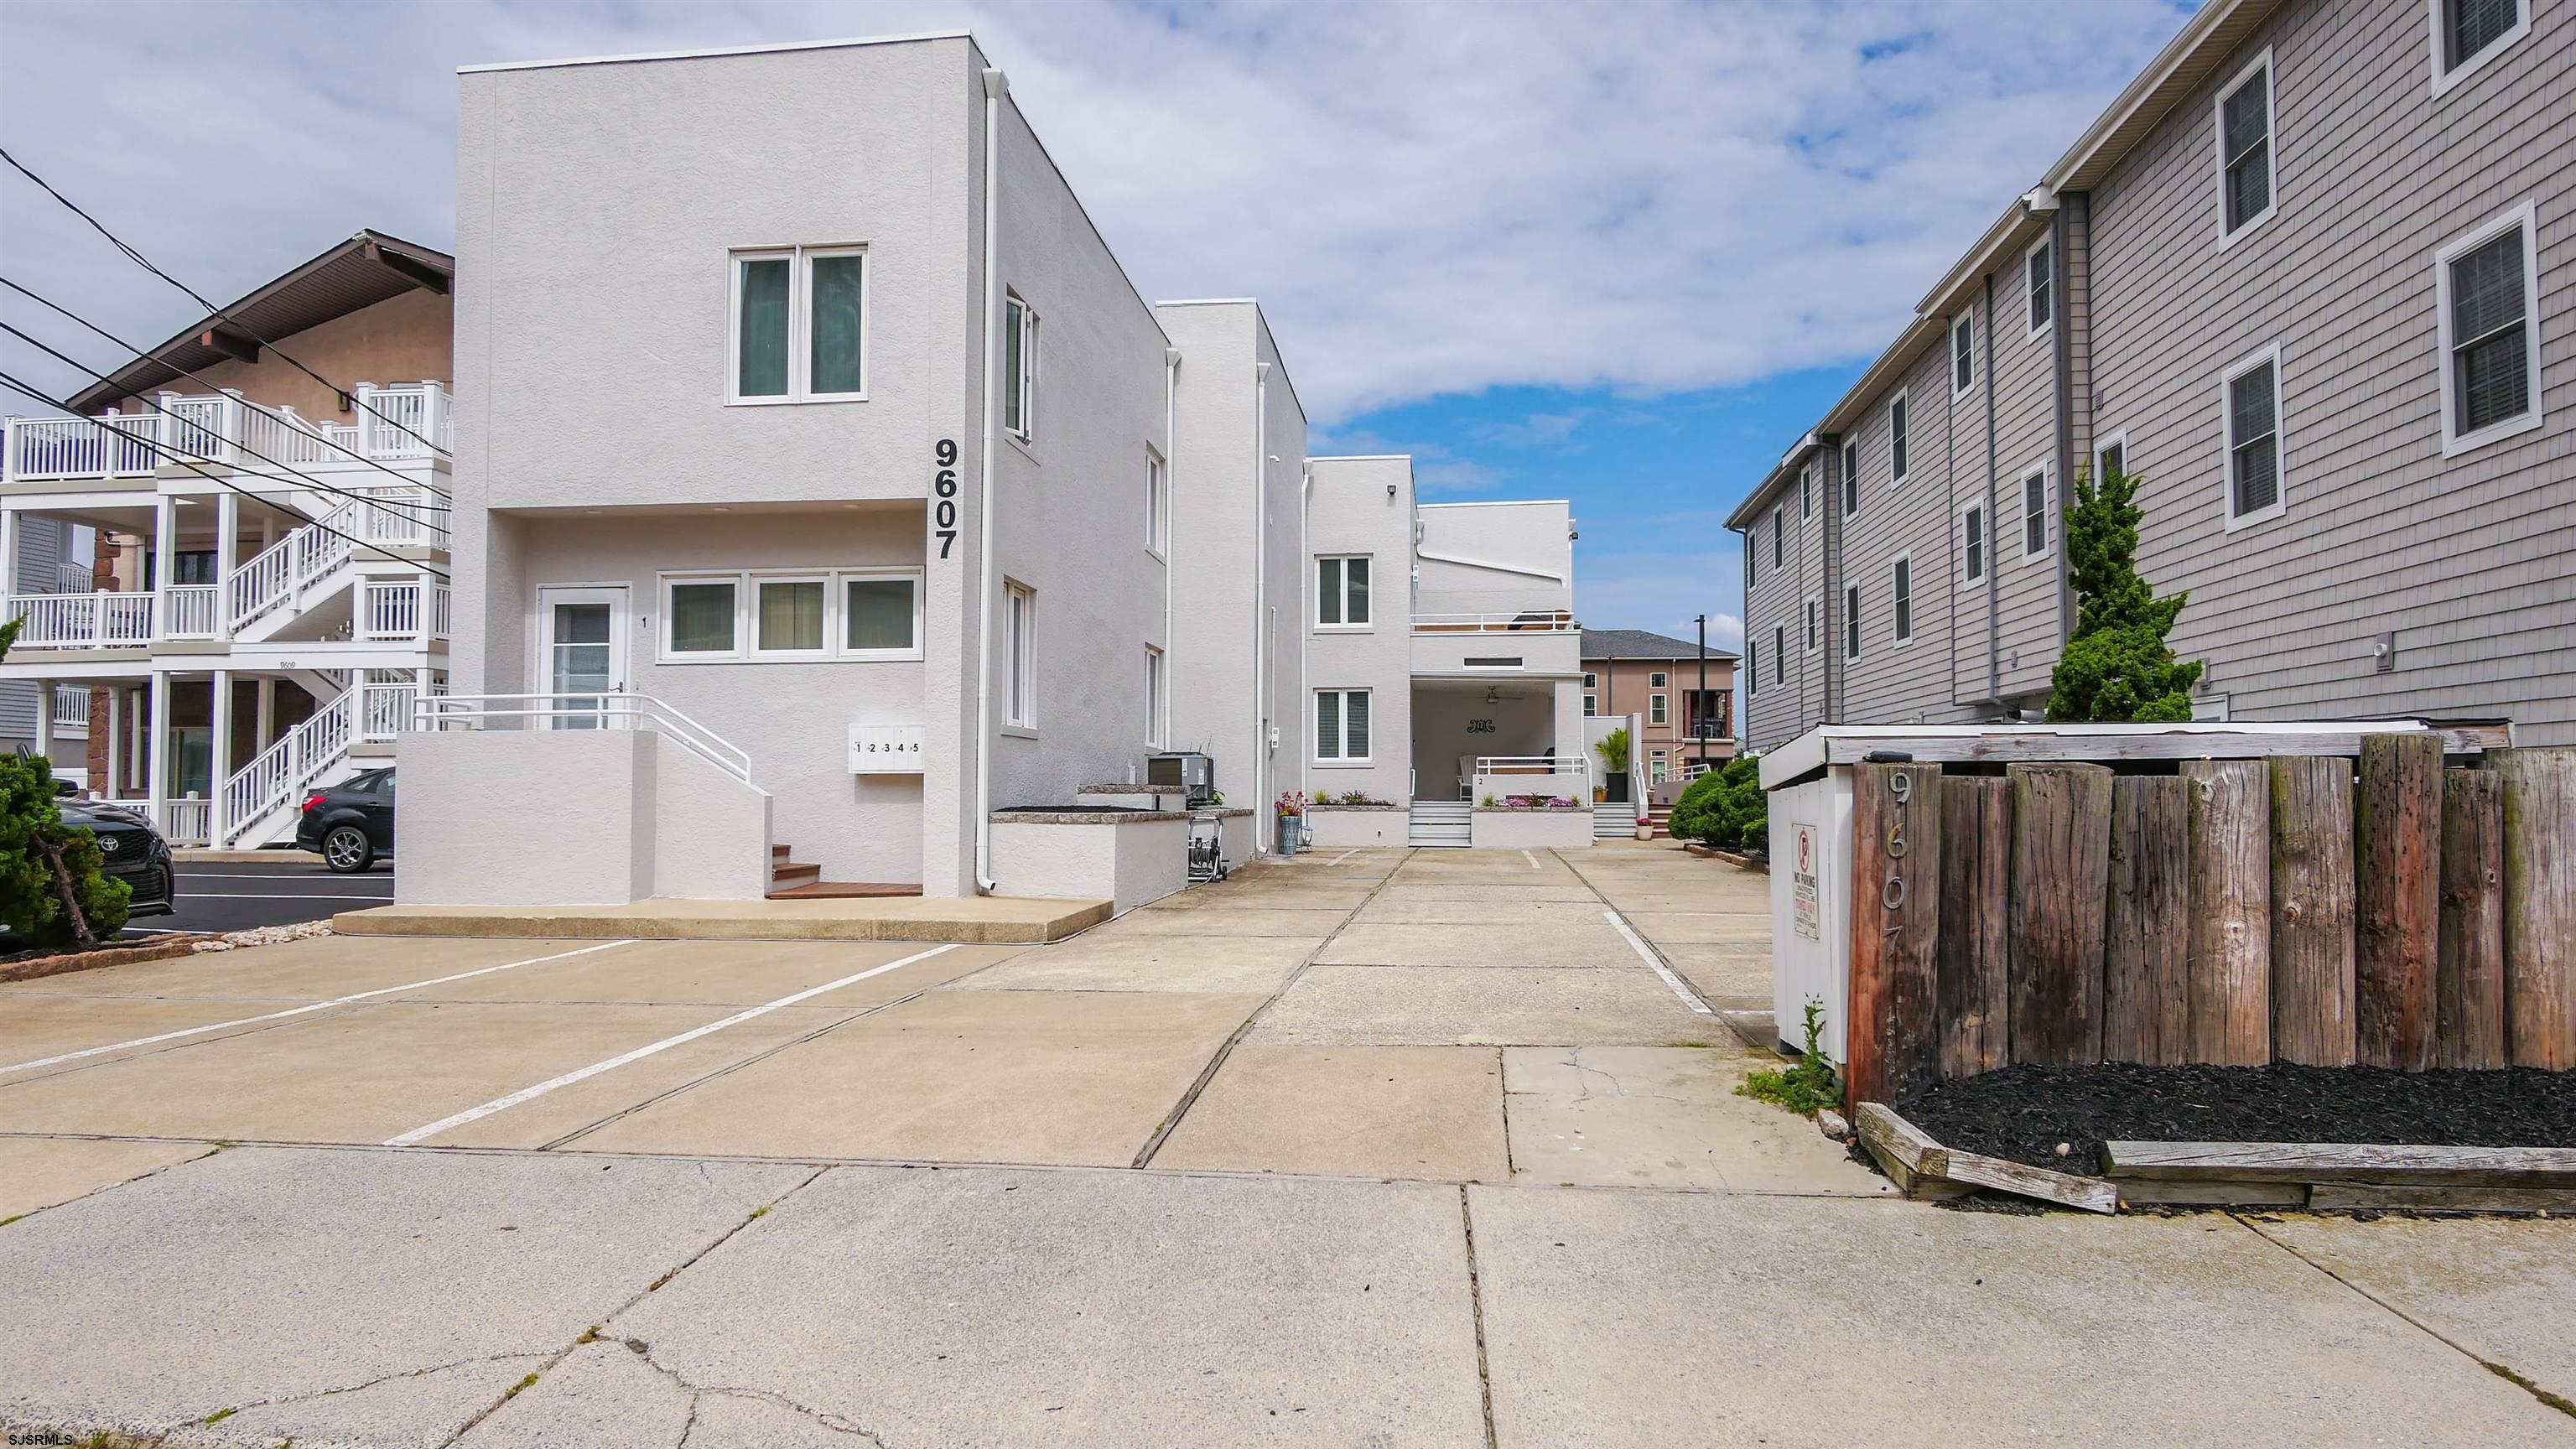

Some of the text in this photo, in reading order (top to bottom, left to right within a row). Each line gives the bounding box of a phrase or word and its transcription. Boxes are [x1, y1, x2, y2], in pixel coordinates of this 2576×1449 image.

[935, 439, 958, 559] 9607
[642, 616, 647, 628] 1
[856, 743, 919, 752] 1 2 3 4 5
[1882, 772, 1912, 960] 9607
[1794, 871, 1815, 889] NO PARKING
